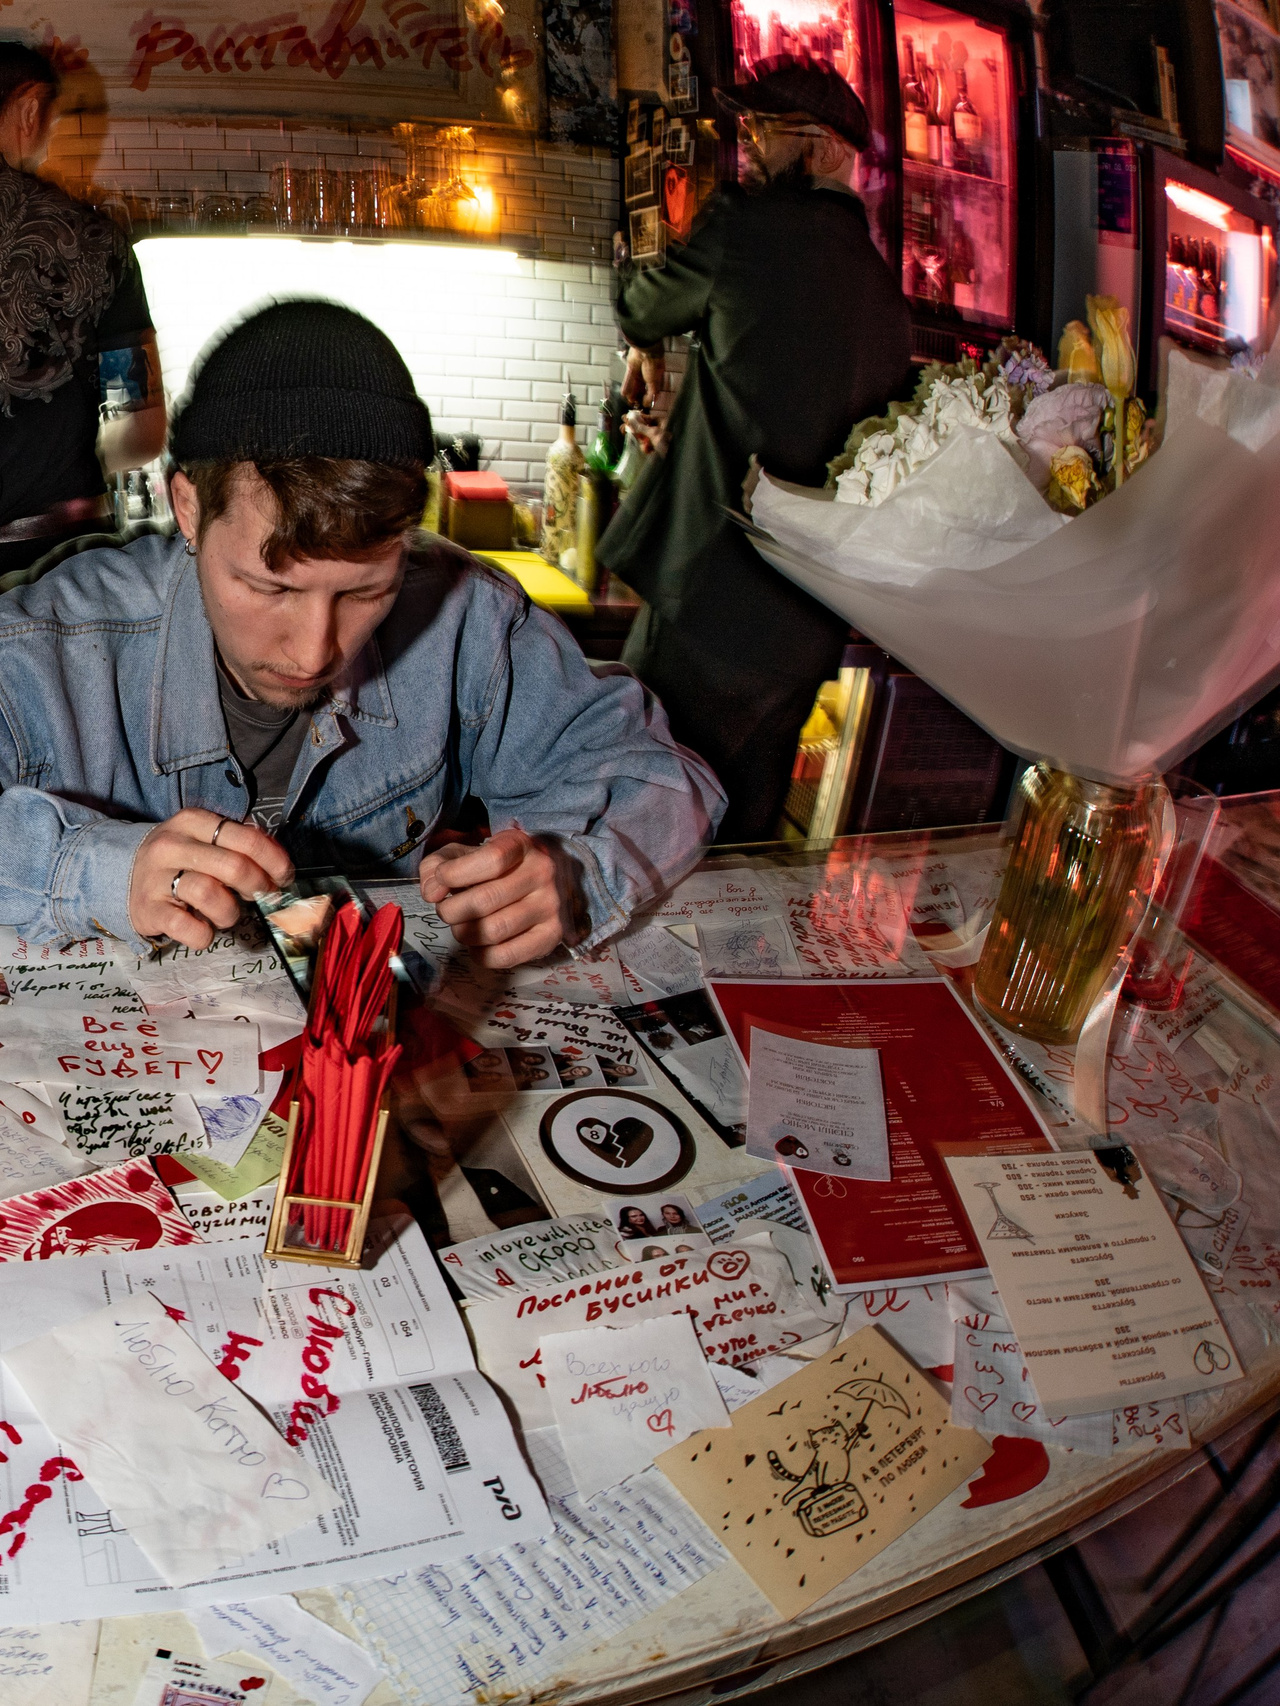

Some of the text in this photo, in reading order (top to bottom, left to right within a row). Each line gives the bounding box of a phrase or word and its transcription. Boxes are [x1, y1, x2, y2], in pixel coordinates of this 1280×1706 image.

[1026, 1160, 1059, 1168] тарелка
[1031, 1170, 1064, 1178] тарелка
[1065, 1178, 1096, 1186] Оливки
[1044, 1190, 1069, 1198] орехи
[1071, 1187, 1103, 1196] Пряные
[1054, 1211, 1089, 1219] Закуски
[1111, 1236, 1150, 1247] прошутто
[1012, 1249, 1056, 1257] томатами
[1058, 1243, 1101, 1253] вялеными
[380, 1277, 391, 1288] 03
[1026, 1298, 1053, 1306] песто
[1063, 1291, 1106, 1302] томатами
[400, 1320, 413, 1338] 054
[1180, 1320, 1212, 1334] красной
[1114, 1336, 1140, 1348] икрой
[1141, 1330, 1171, 1343] черной
[1024, 1348, 1061, 1357] маслом
[1063, 1343, 1104, 1354] взбитым
[1119, 1371, 1166, 1386] Брускетты
[367, 1392, 405, 1465] АЛЕКСАНДРОВНА
[401, 1442, 426, 1492] ВИКТОРИЯ
